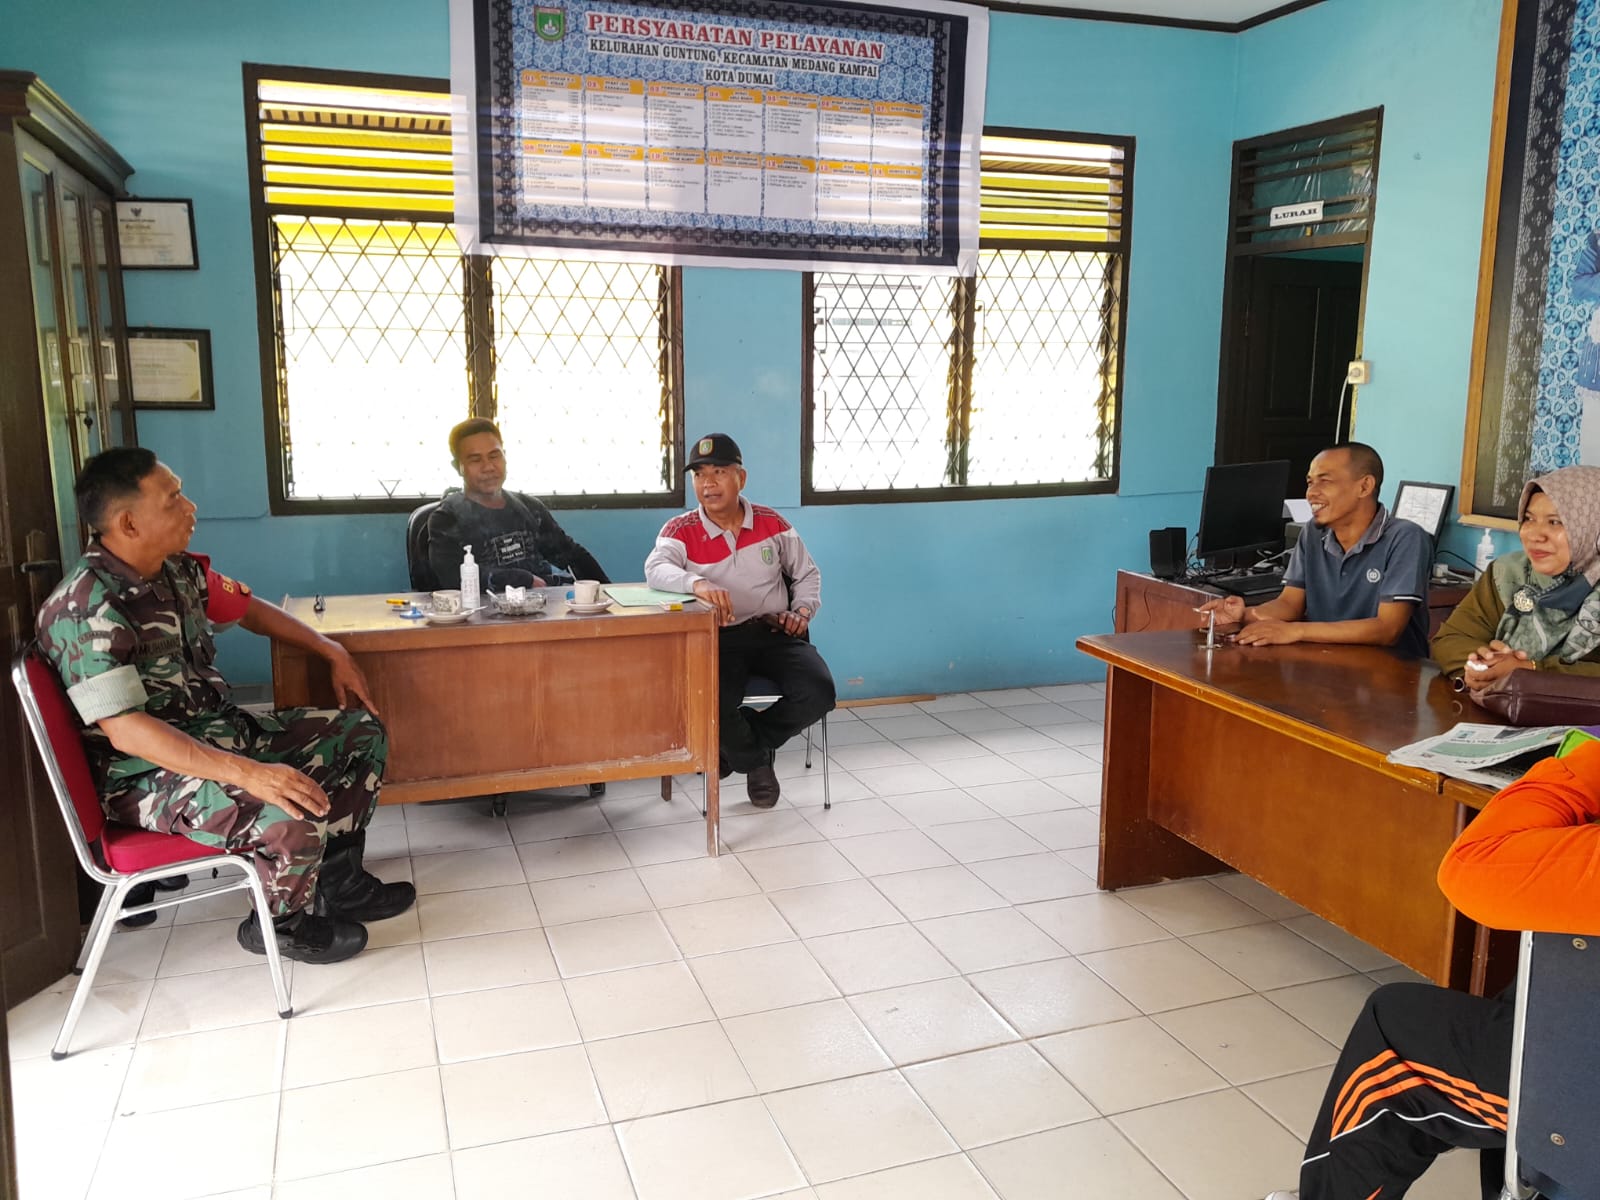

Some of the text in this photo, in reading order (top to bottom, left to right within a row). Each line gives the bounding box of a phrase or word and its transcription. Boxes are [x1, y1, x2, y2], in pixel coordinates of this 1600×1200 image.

[587, 13, 883, 59] PERSYARATAN PELAYANAN
[590, 39, 877, 77] KELURAHAN GUNTUNG, KECAMATAN MEDANG KAMPAI
[705, 69, 773, 85] KOTA DUMAI
[1274, 208, 1317, 220] LURAH
